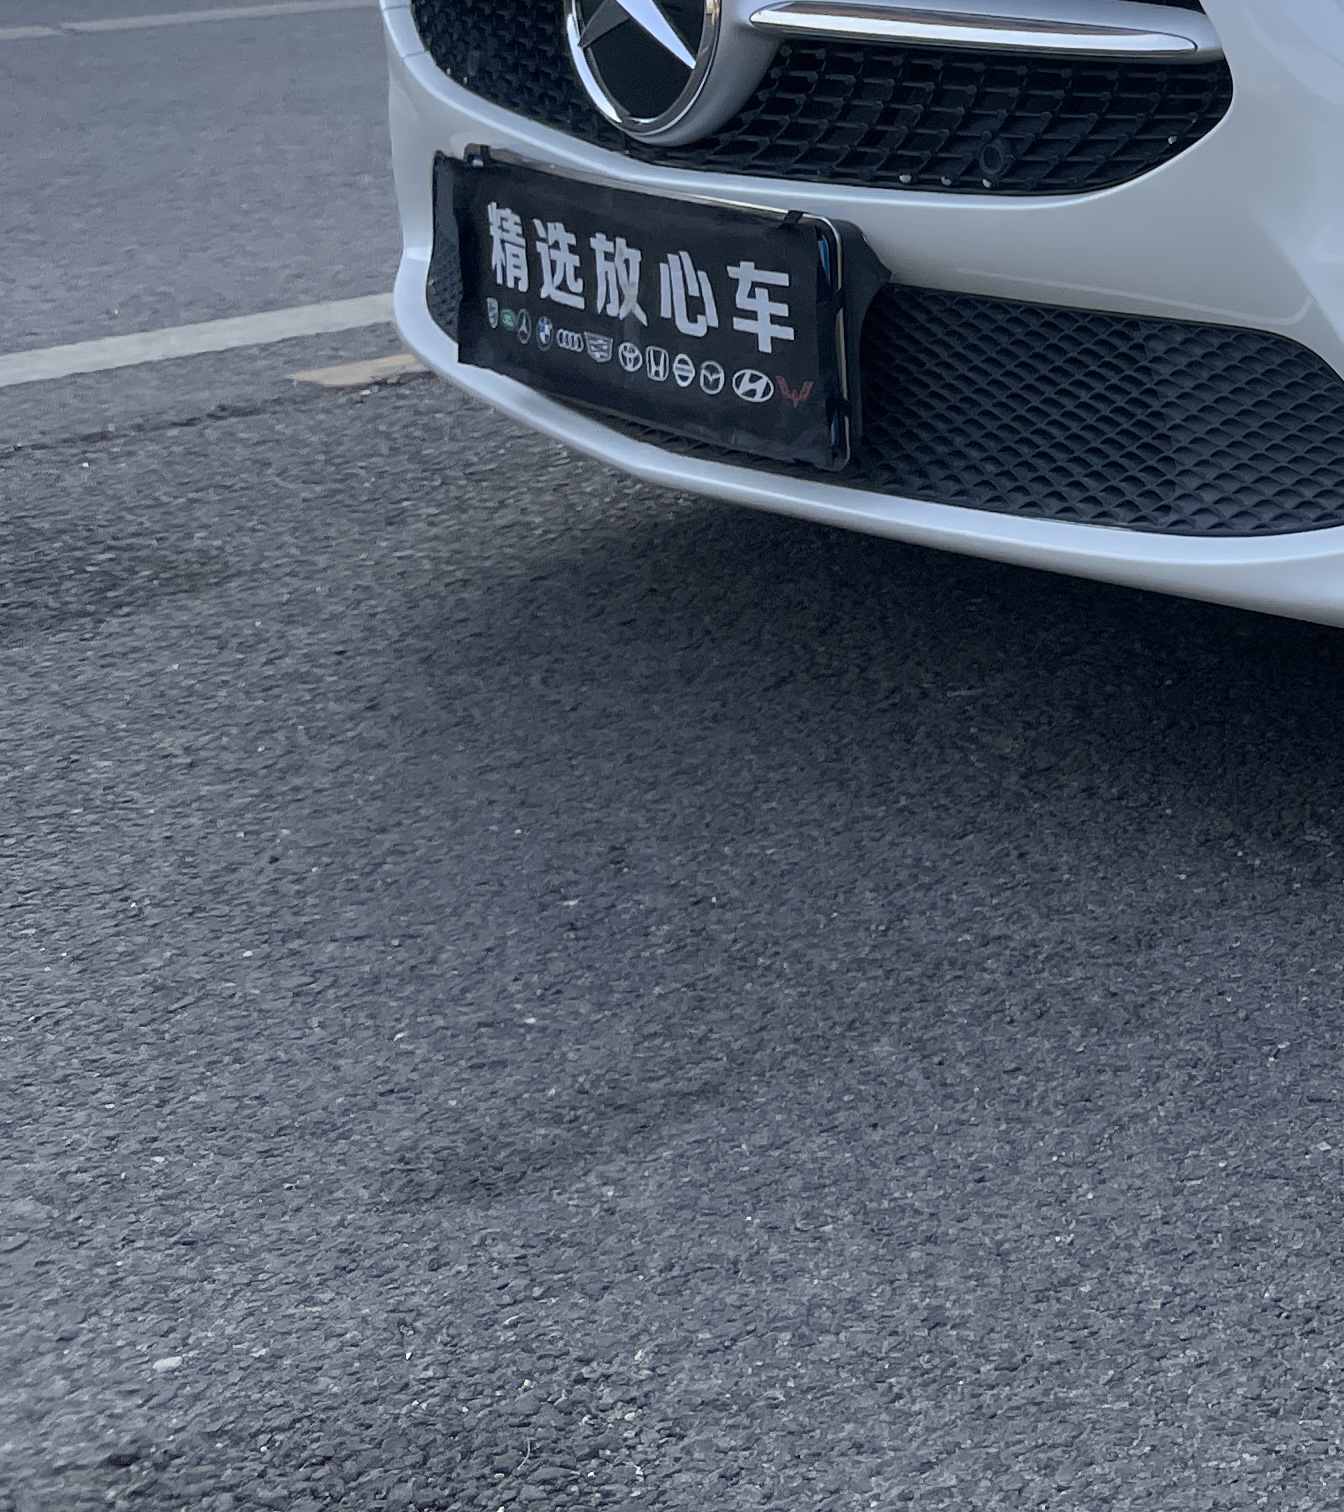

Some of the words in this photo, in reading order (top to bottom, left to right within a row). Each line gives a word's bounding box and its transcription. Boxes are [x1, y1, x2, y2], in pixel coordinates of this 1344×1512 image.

[486, 201, 795, 354] 精选放心车
